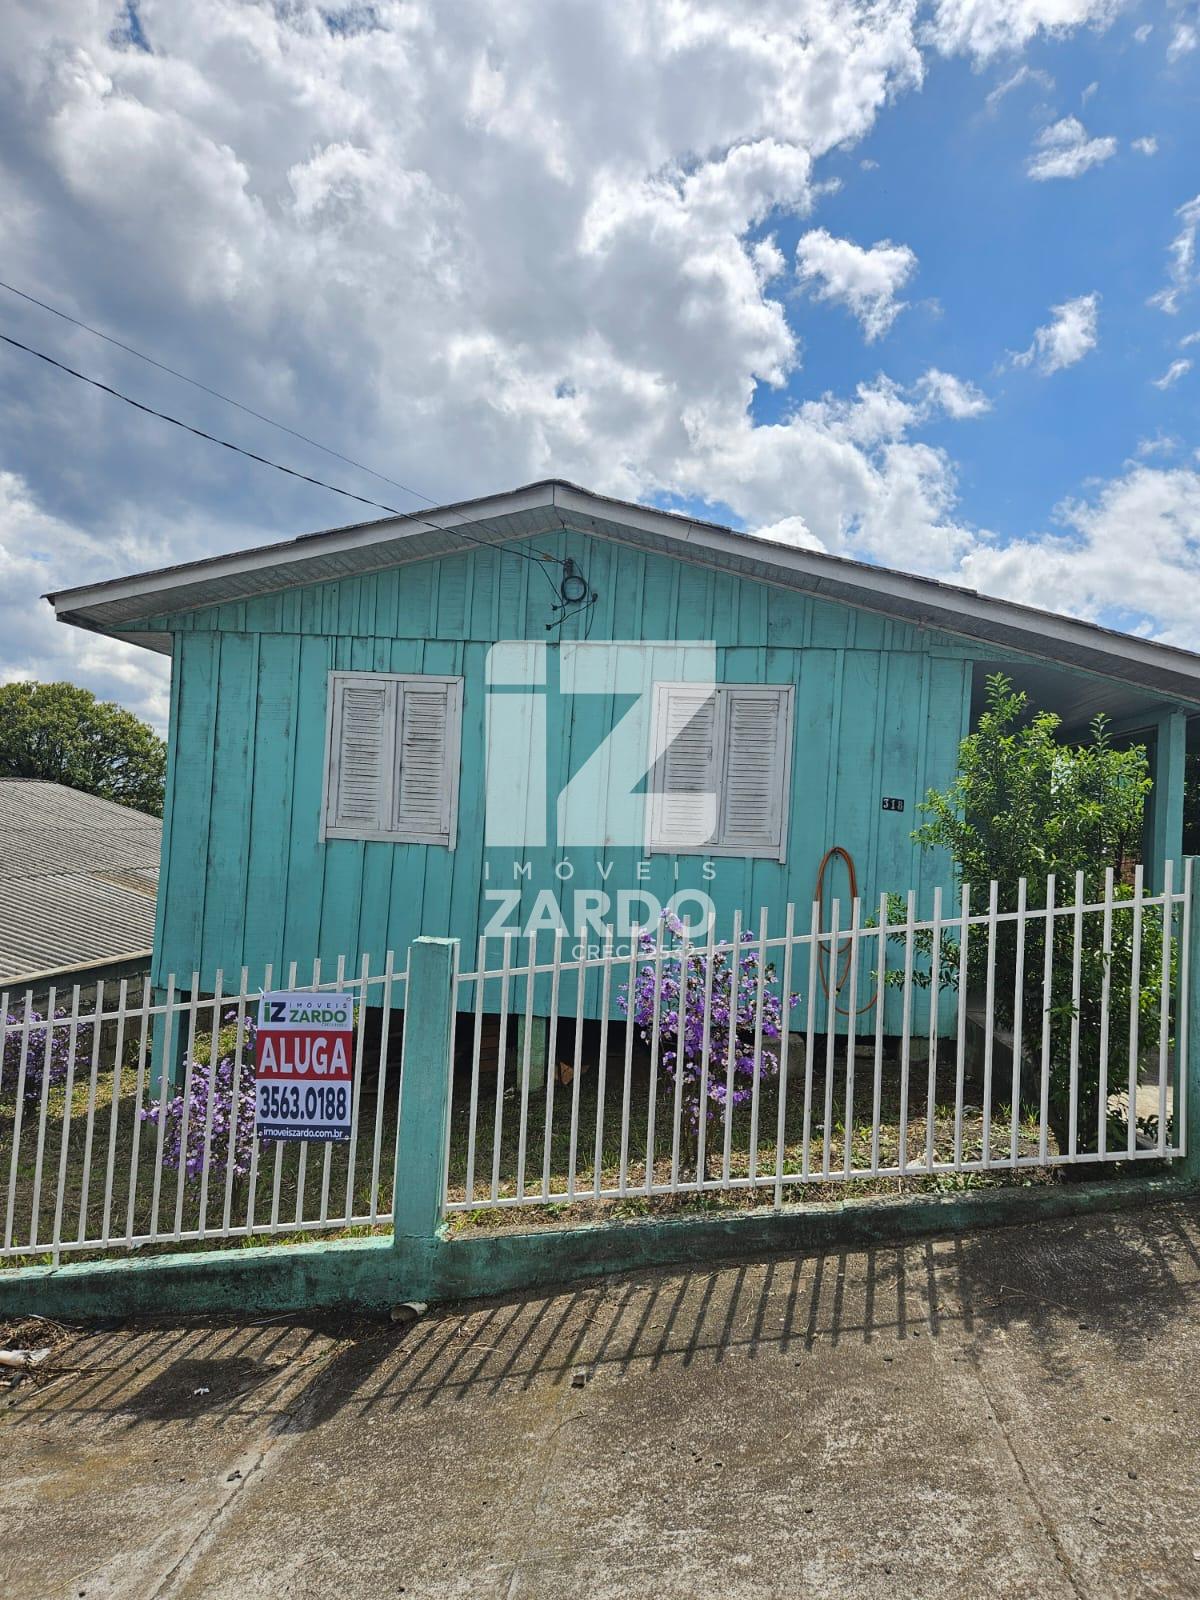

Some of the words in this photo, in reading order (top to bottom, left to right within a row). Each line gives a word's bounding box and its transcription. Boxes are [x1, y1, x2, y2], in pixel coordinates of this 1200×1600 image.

[289, 1009, 347, 1023] ZARDO
[259, 1037, 348, 1074] ALUGA
[260, 1085, 347, 1120] 3563.0188
[263, 1126, 343, 1138] imoveiszardo.com.br
